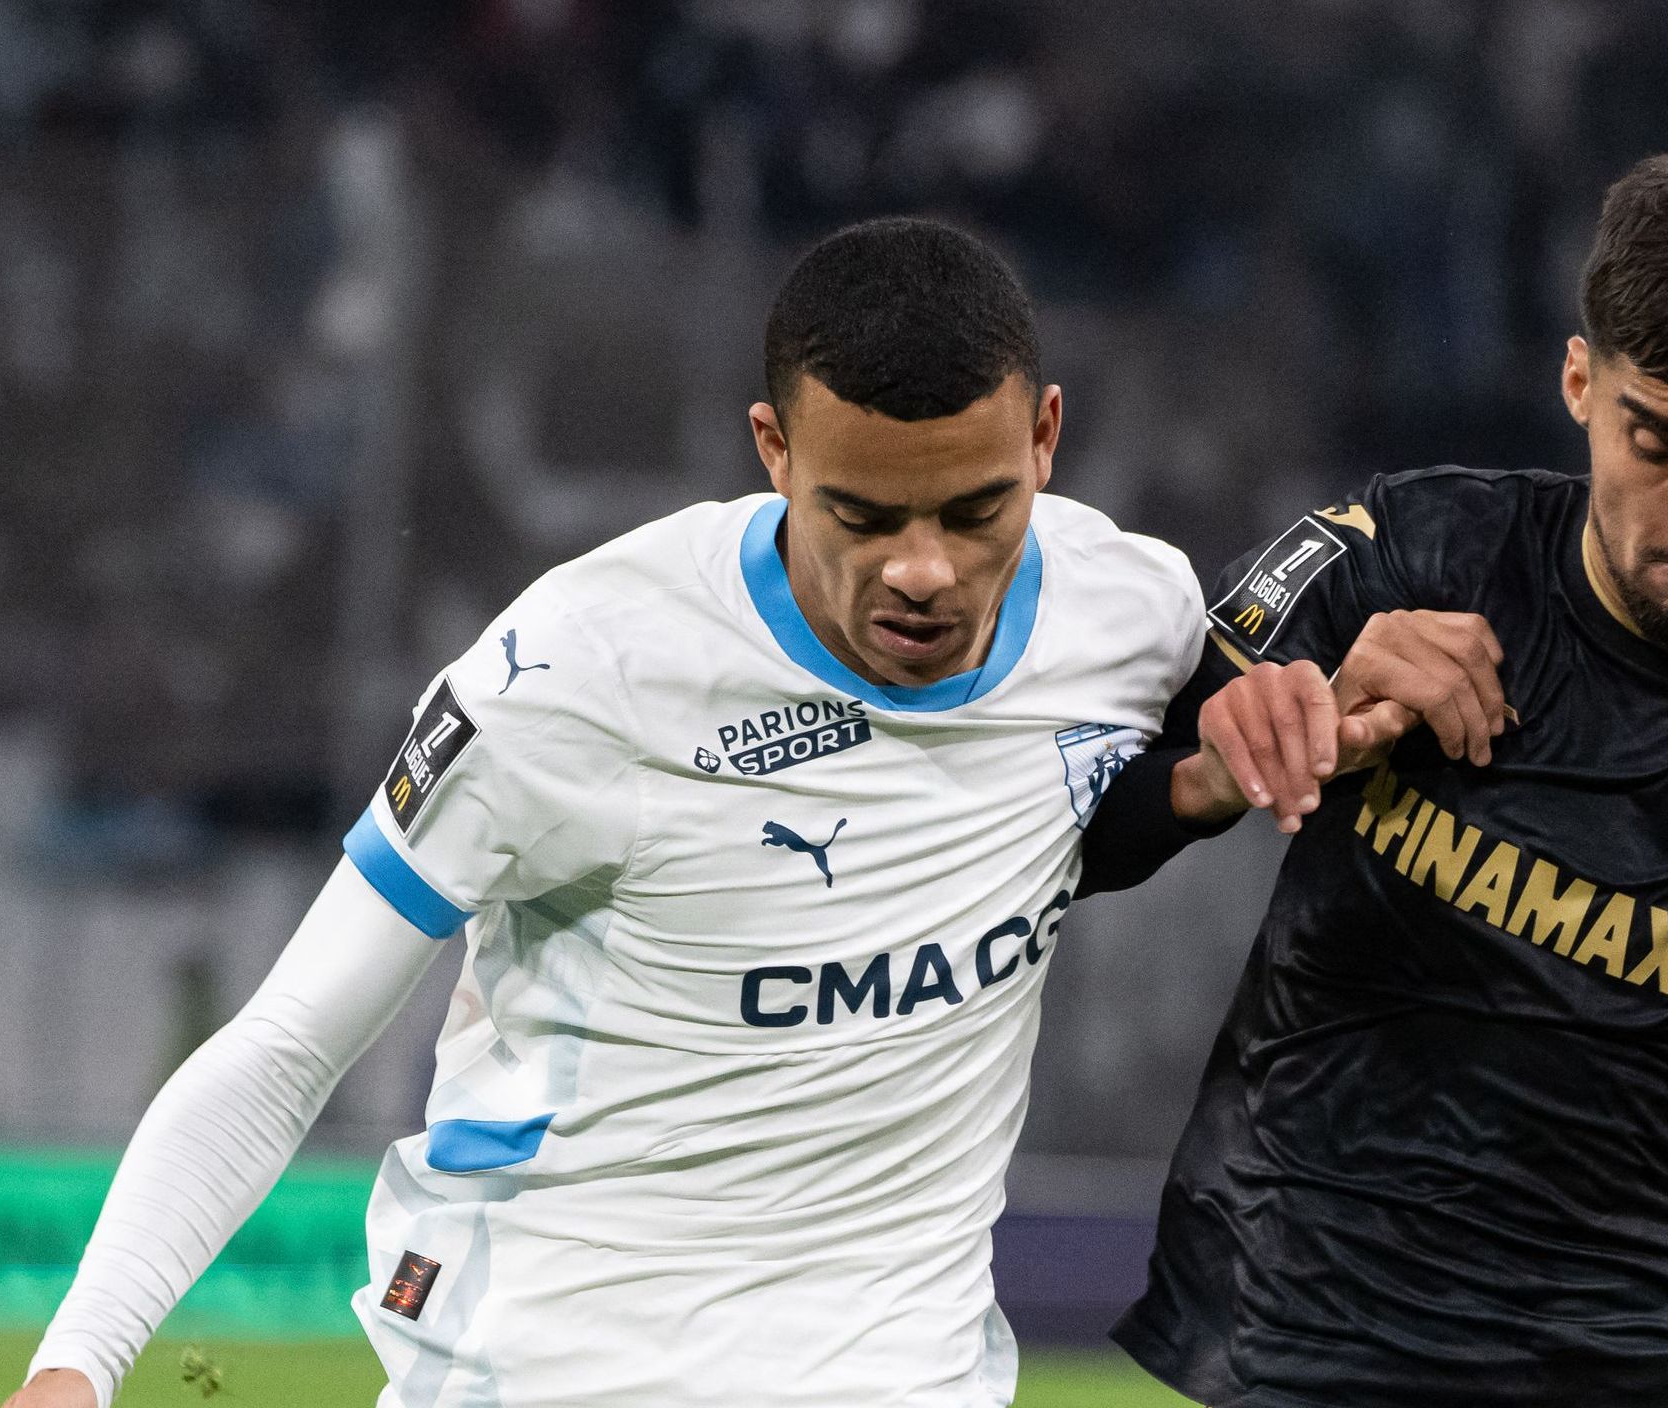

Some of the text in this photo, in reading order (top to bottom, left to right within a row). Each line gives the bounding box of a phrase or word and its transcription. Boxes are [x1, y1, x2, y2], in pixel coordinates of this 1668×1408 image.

[718, 700, 866, 752] PARIONS
[738, 720, 863, 774] SPORT
[740, 943, 964, 1028] CMA
